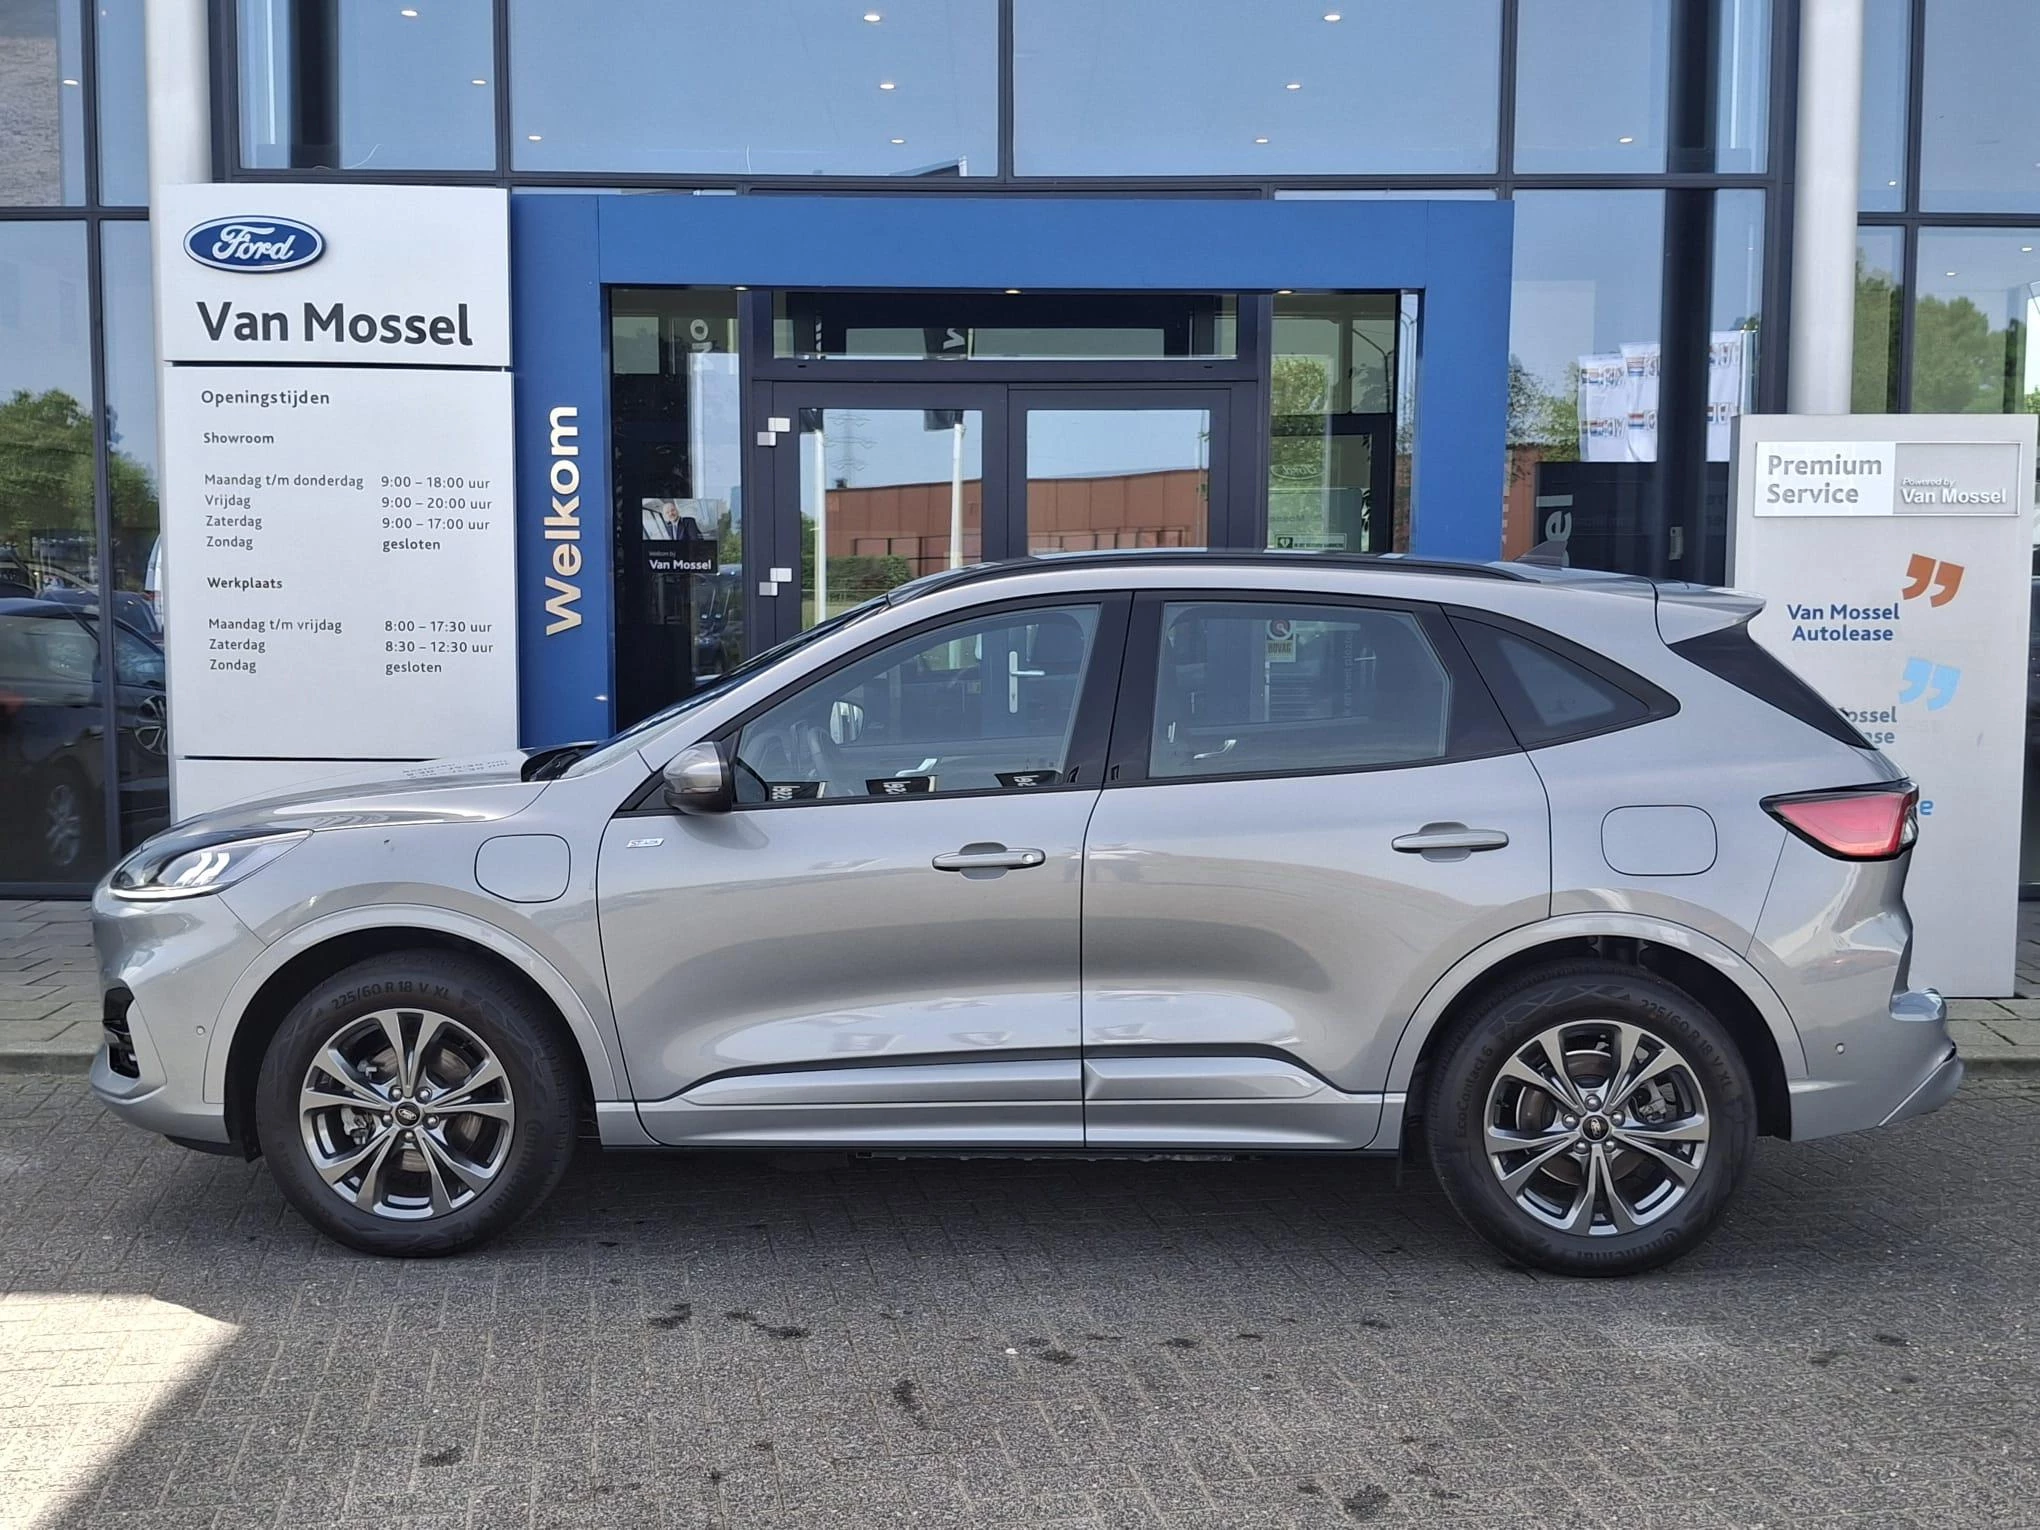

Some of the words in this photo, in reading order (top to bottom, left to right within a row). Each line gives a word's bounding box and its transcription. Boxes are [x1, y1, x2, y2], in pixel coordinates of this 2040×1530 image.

[212, 225, 296, 260] Ford
[195, 301, 289, 342] Van
[303, 302, 474, 346] Mossel
[201, 389, 330, 409] Openingstijden
[203, 431, 275, 444] Showroom
[1767, 453, 1882, 476] Premium
[204, 473, 262, 489] Maandag
[265, 473, 290, 486] t/m
[293, 473, 364, 491] donderdag
[381, 475, 412, 488] 9:00
[426, 476, 464, 489] 18:00
[468, 479, 491, 489] uur
[1944, 477, 1956, 488] by
[1766, 481, 1859, 504] Service
[1902, 488, 1936, 503] Van
[1942, 488, 2007, 503] Mossel
[204, 493, 251, 510] Vrijdag
[381, 496, 412, 509] 9:00
[427, 497, 466, 510] 20:00
[470, 500, 492, 510] uur
[205, 514, 263, 531] Zaterdag
[382, 517, 413, 529] 9:00
[427, 517, 464, 530] 17:00
[468, 521, 490, 530] uur
[544, 406, 582, 636] Welkom
[206, 535, 254, 551] Zondag
[382, 537, 441, 553] gesloten
[649, 559, 671, 570] Van
[673, 559, 712, 570] Mossel
[206, 576, 283, 592] Werkplaats
[1786, 603, 1824, 621] Van
[1830, 602, 1900, 620] Mossel
[208, 617, 266, 634] Maandag
[269, 618, 294, 631] t/m
[296, 618, 343, 635] vrijdag
[384, 620, 415, 632] 8:00
[430, 620, 466, 633] 17:30
[470, 623, 493, 633] uur
[1791, 623, 1894, 642] Autolease
[209, 638, 266, 654] Zaterdag
[385, 640, 416, 653] 8:30
[430, 641, 468, 653] 12:30
[471, 644, 494, 653] uur
[209, 658, 257, 674] Zondag
[385, 660, 442, 676] gesloten
[1845, 706, 1897, 723] ossel
[331, 983, 380, 1010] 225/60
[385, 981, 395, 993] R
[399, 981, 412, 993] 18
